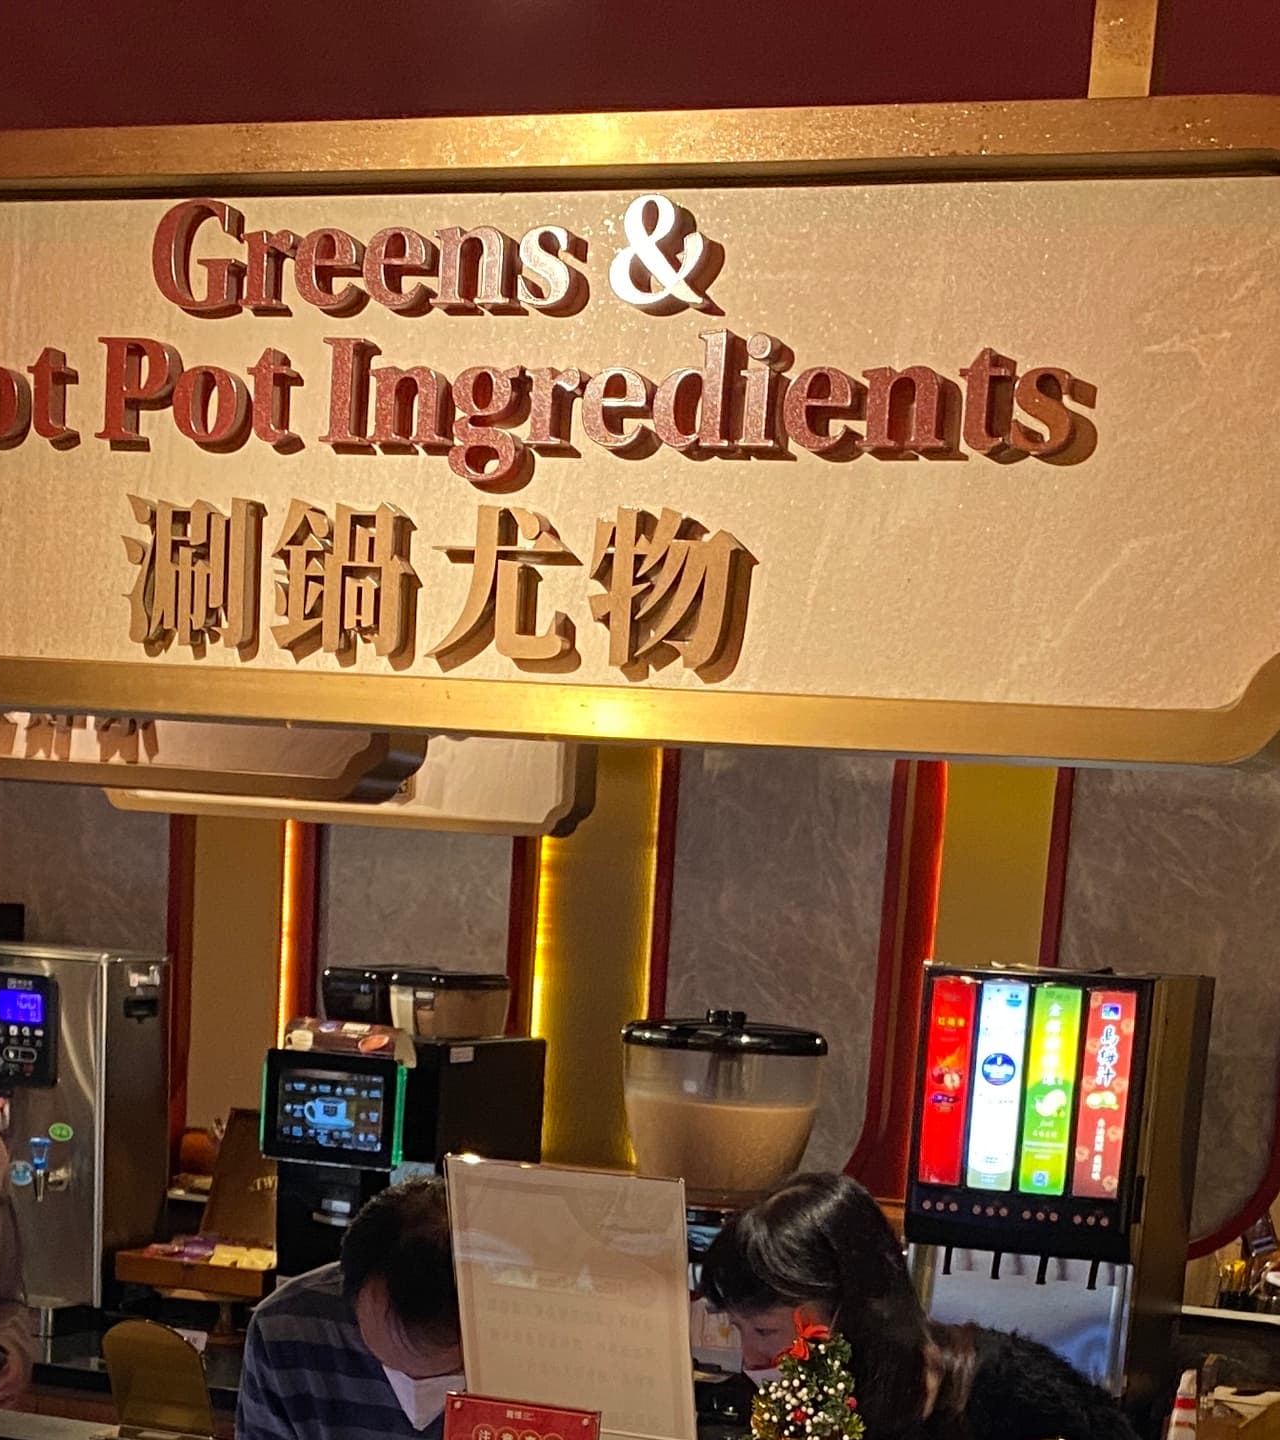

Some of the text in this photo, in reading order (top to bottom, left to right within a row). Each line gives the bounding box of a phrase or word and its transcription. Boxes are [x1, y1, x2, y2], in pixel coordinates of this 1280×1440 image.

[152, 193, 724, 318] Greens &
[95, 337, 304, 454] Pot
[319, 330, 1097, 493] Ingredients
[122, 494, 758, 683] 涮鍋尤物
